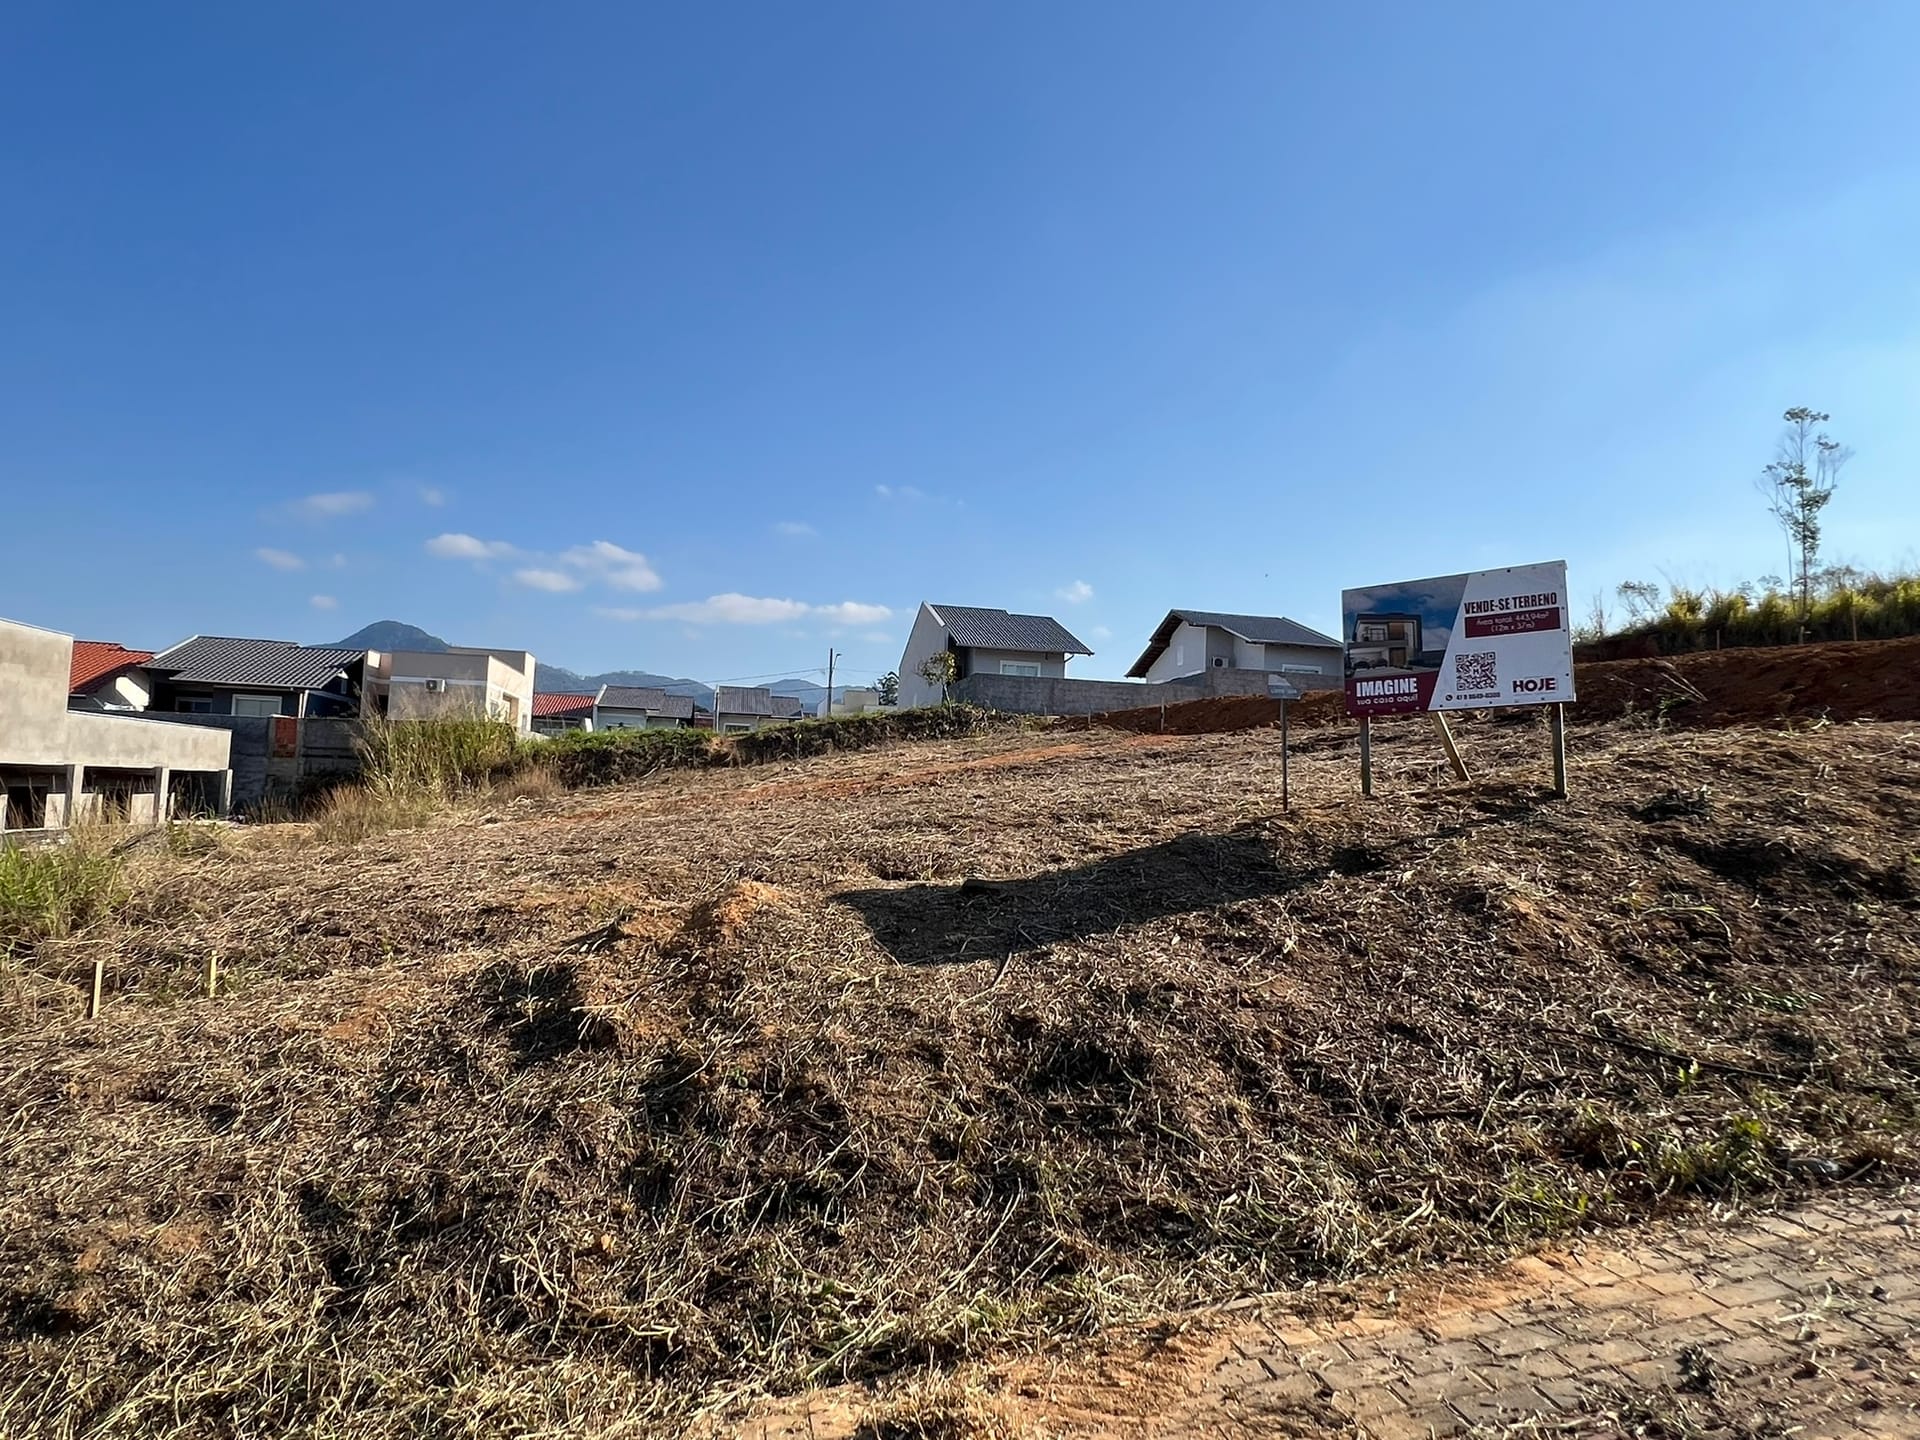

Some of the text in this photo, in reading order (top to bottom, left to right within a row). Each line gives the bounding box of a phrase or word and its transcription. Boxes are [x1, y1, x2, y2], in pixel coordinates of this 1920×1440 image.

[1464, 592, 1558, 614] VENDE-SE TERRENO
[1356, 678, 1418, 697] IMAGINE
[1512, 677, 1556, 693] HOJE
